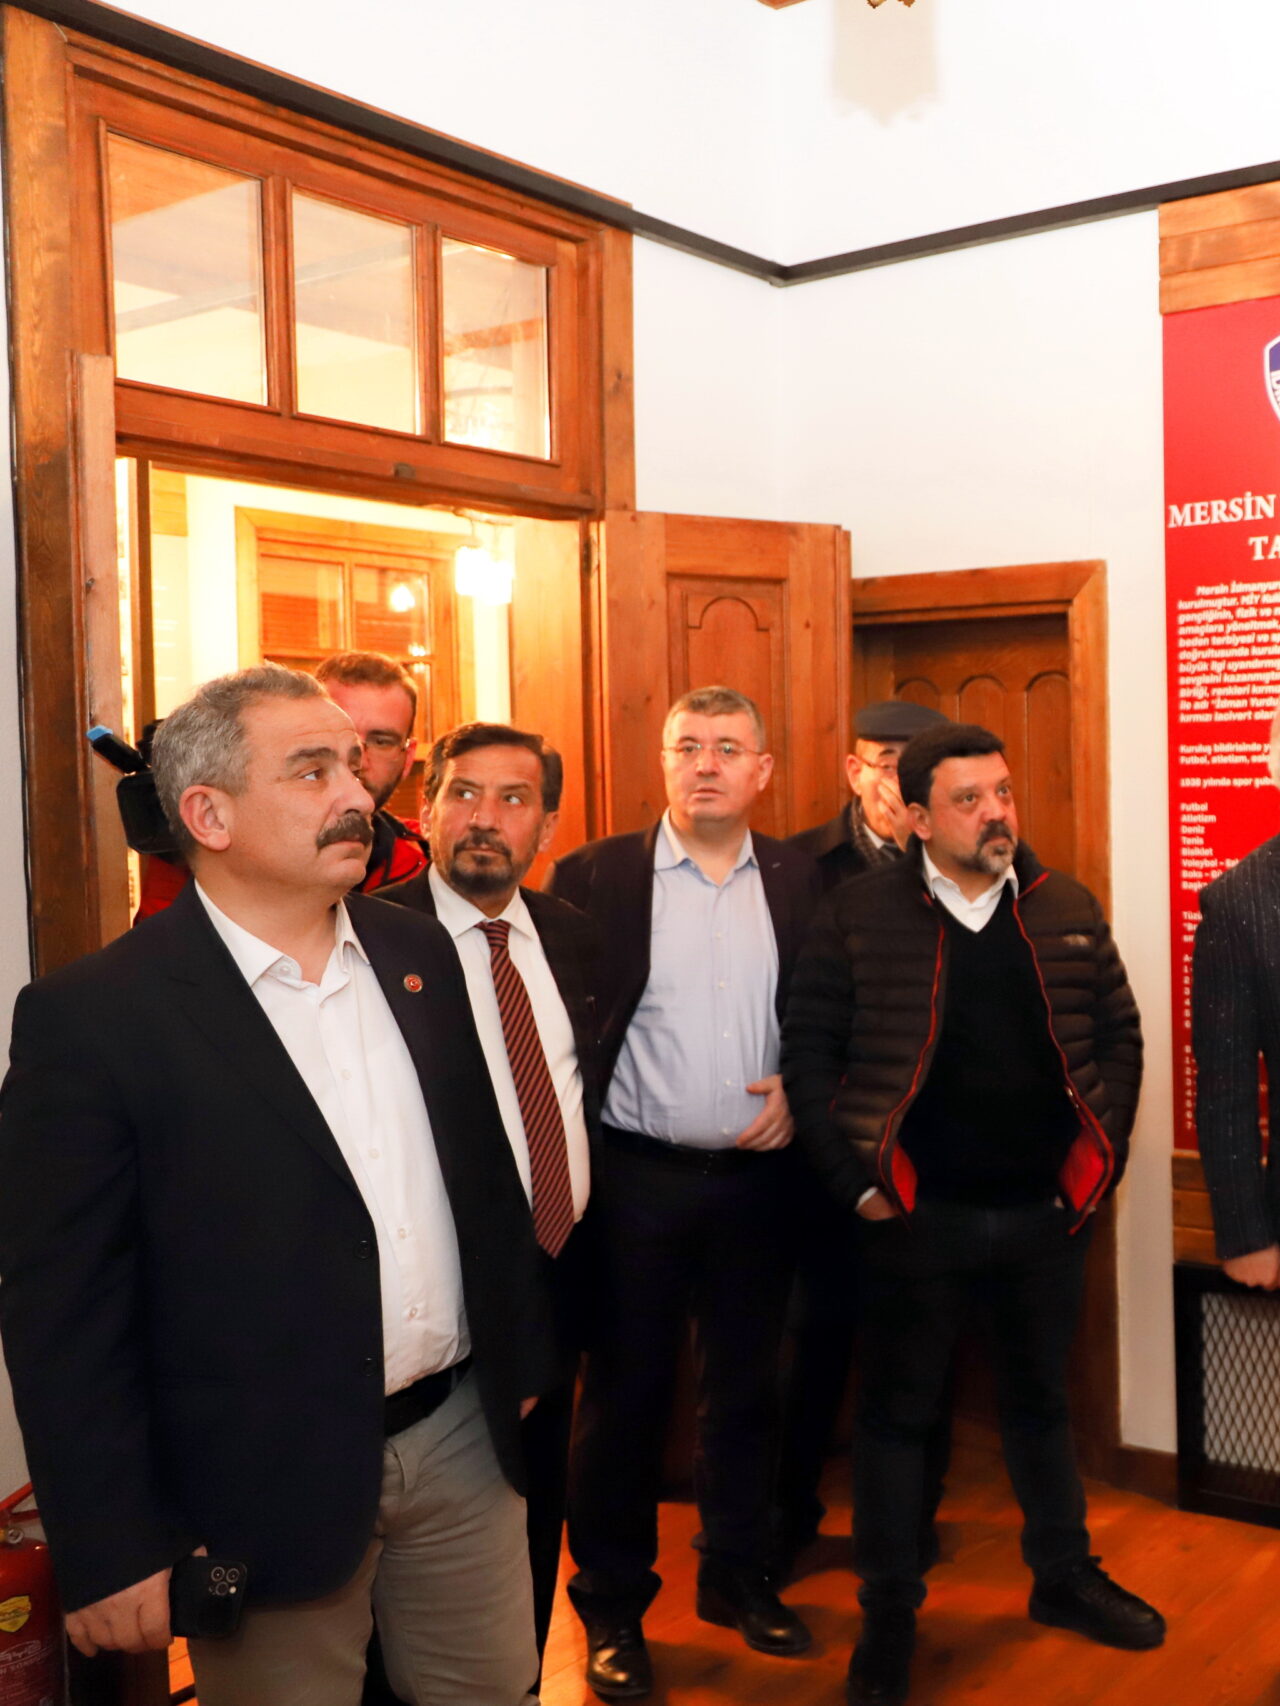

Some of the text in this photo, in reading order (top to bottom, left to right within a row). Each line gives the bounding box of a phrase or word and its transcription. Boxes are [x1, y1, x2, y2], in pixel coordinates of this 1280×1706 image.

[1168, 491, 1276, 528] MERSİN
[1181, 803, 1208, 812] Futbol
[1181, 814, 1216, 823] Atletizm
[1181, 825, 1205, 834] Deniz
[1181, 836, 1204, 845] Tenis
